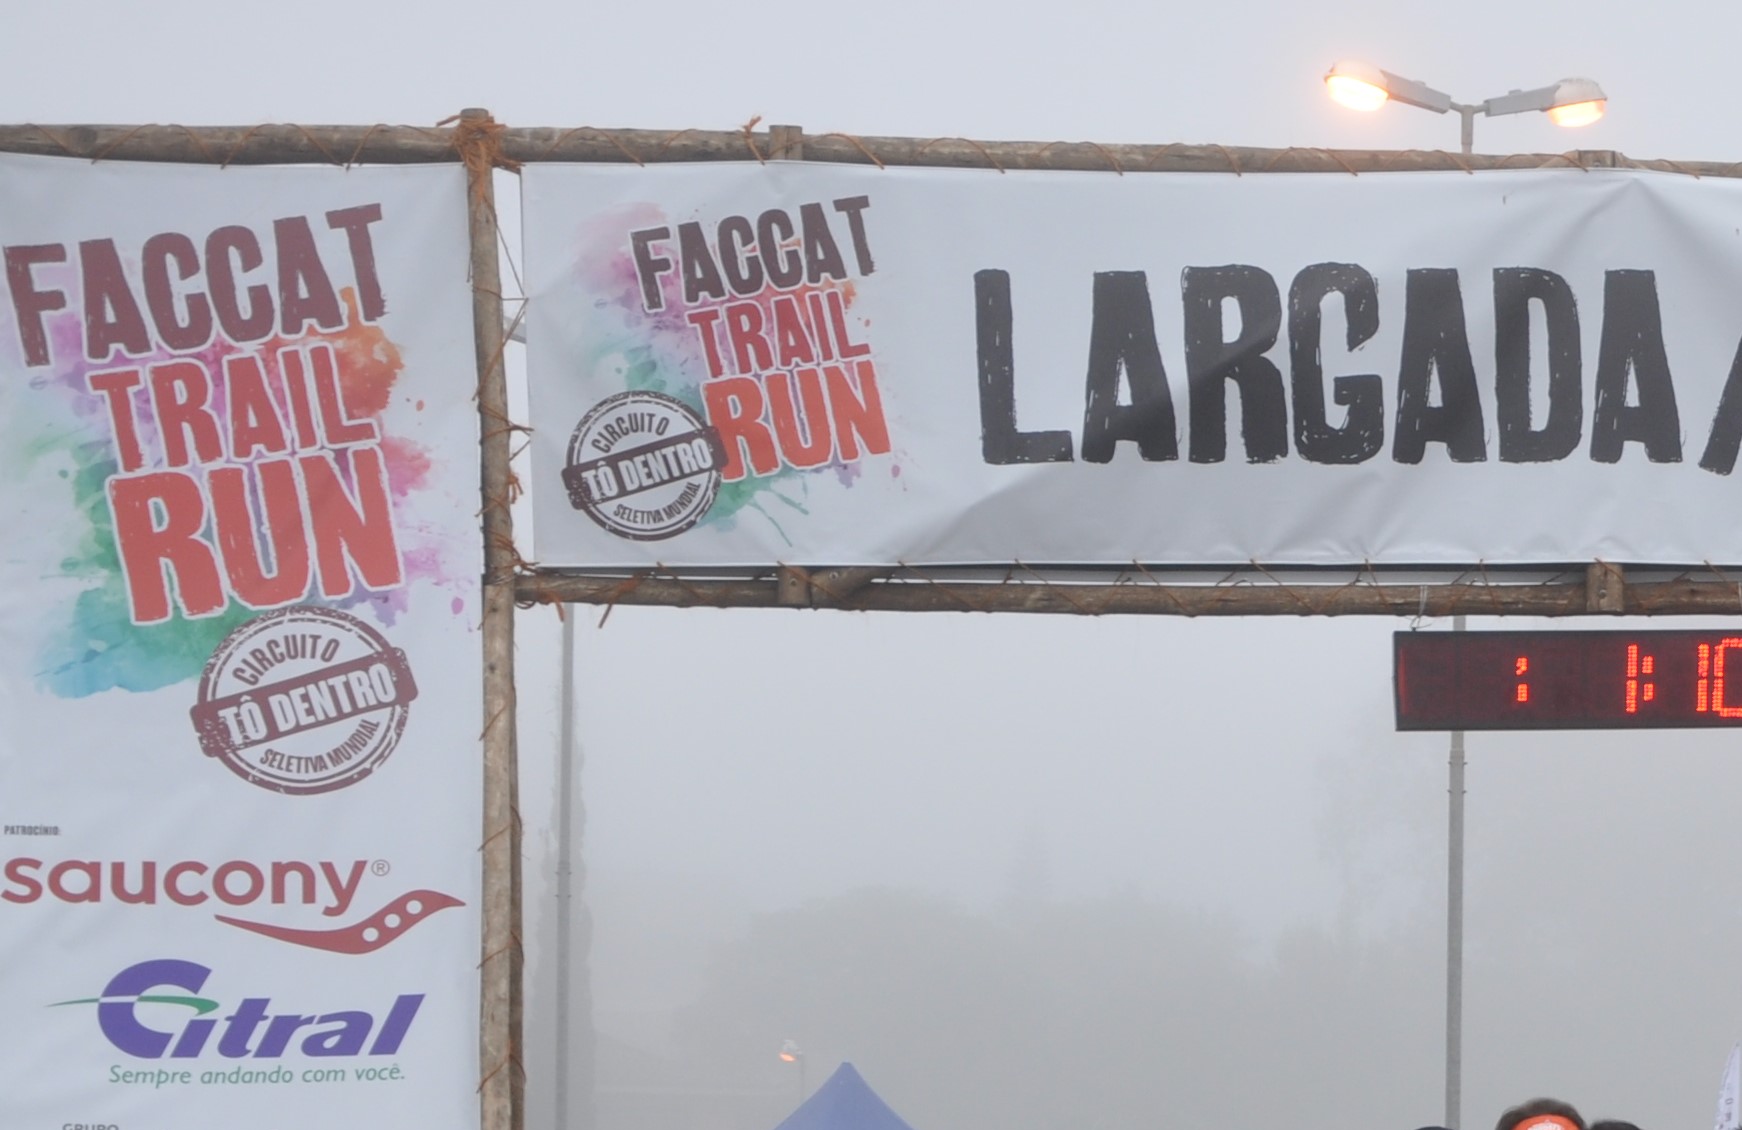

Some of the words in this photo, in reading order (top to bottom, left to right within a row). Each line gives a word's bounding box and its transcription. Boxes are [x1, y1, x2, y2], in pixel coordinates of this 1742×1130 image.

[4, 203, 389, 367] FACCAT
[630, 195, 876, 312] FACCAT
[687, 291, 871, 378] TRAIL
[89, 347, 379, 472] TRAIL
[591, 412, 670, 454] CIRCUITO
[703, 360, 891, 481] RUN
[582, 460, 617, 499] TÔ
[619, 437, 713, 491] DENTRO
[613, 501, 663, 526] SELETIVA
[662, 481, 702, 524] MUNDIAL
[109, 448, 403, 623] RUN
[232, 631, 342, 686] CIRCUITO
[218, 697, 268, 746] TÔ
[270, 664, 396, 730] DENTRO
[259, 748, 328, 774] SELETIVA
[326, 718, 381, 771] MUNDIAL
[97, 959, 426, 1059] Citral
[108, 1064, 191, 1089] Sempre
[200, 1064, 295, 1085] andando
[301, 1066, 346, 1083] com
[354, 1063, 406, 1081] você.
